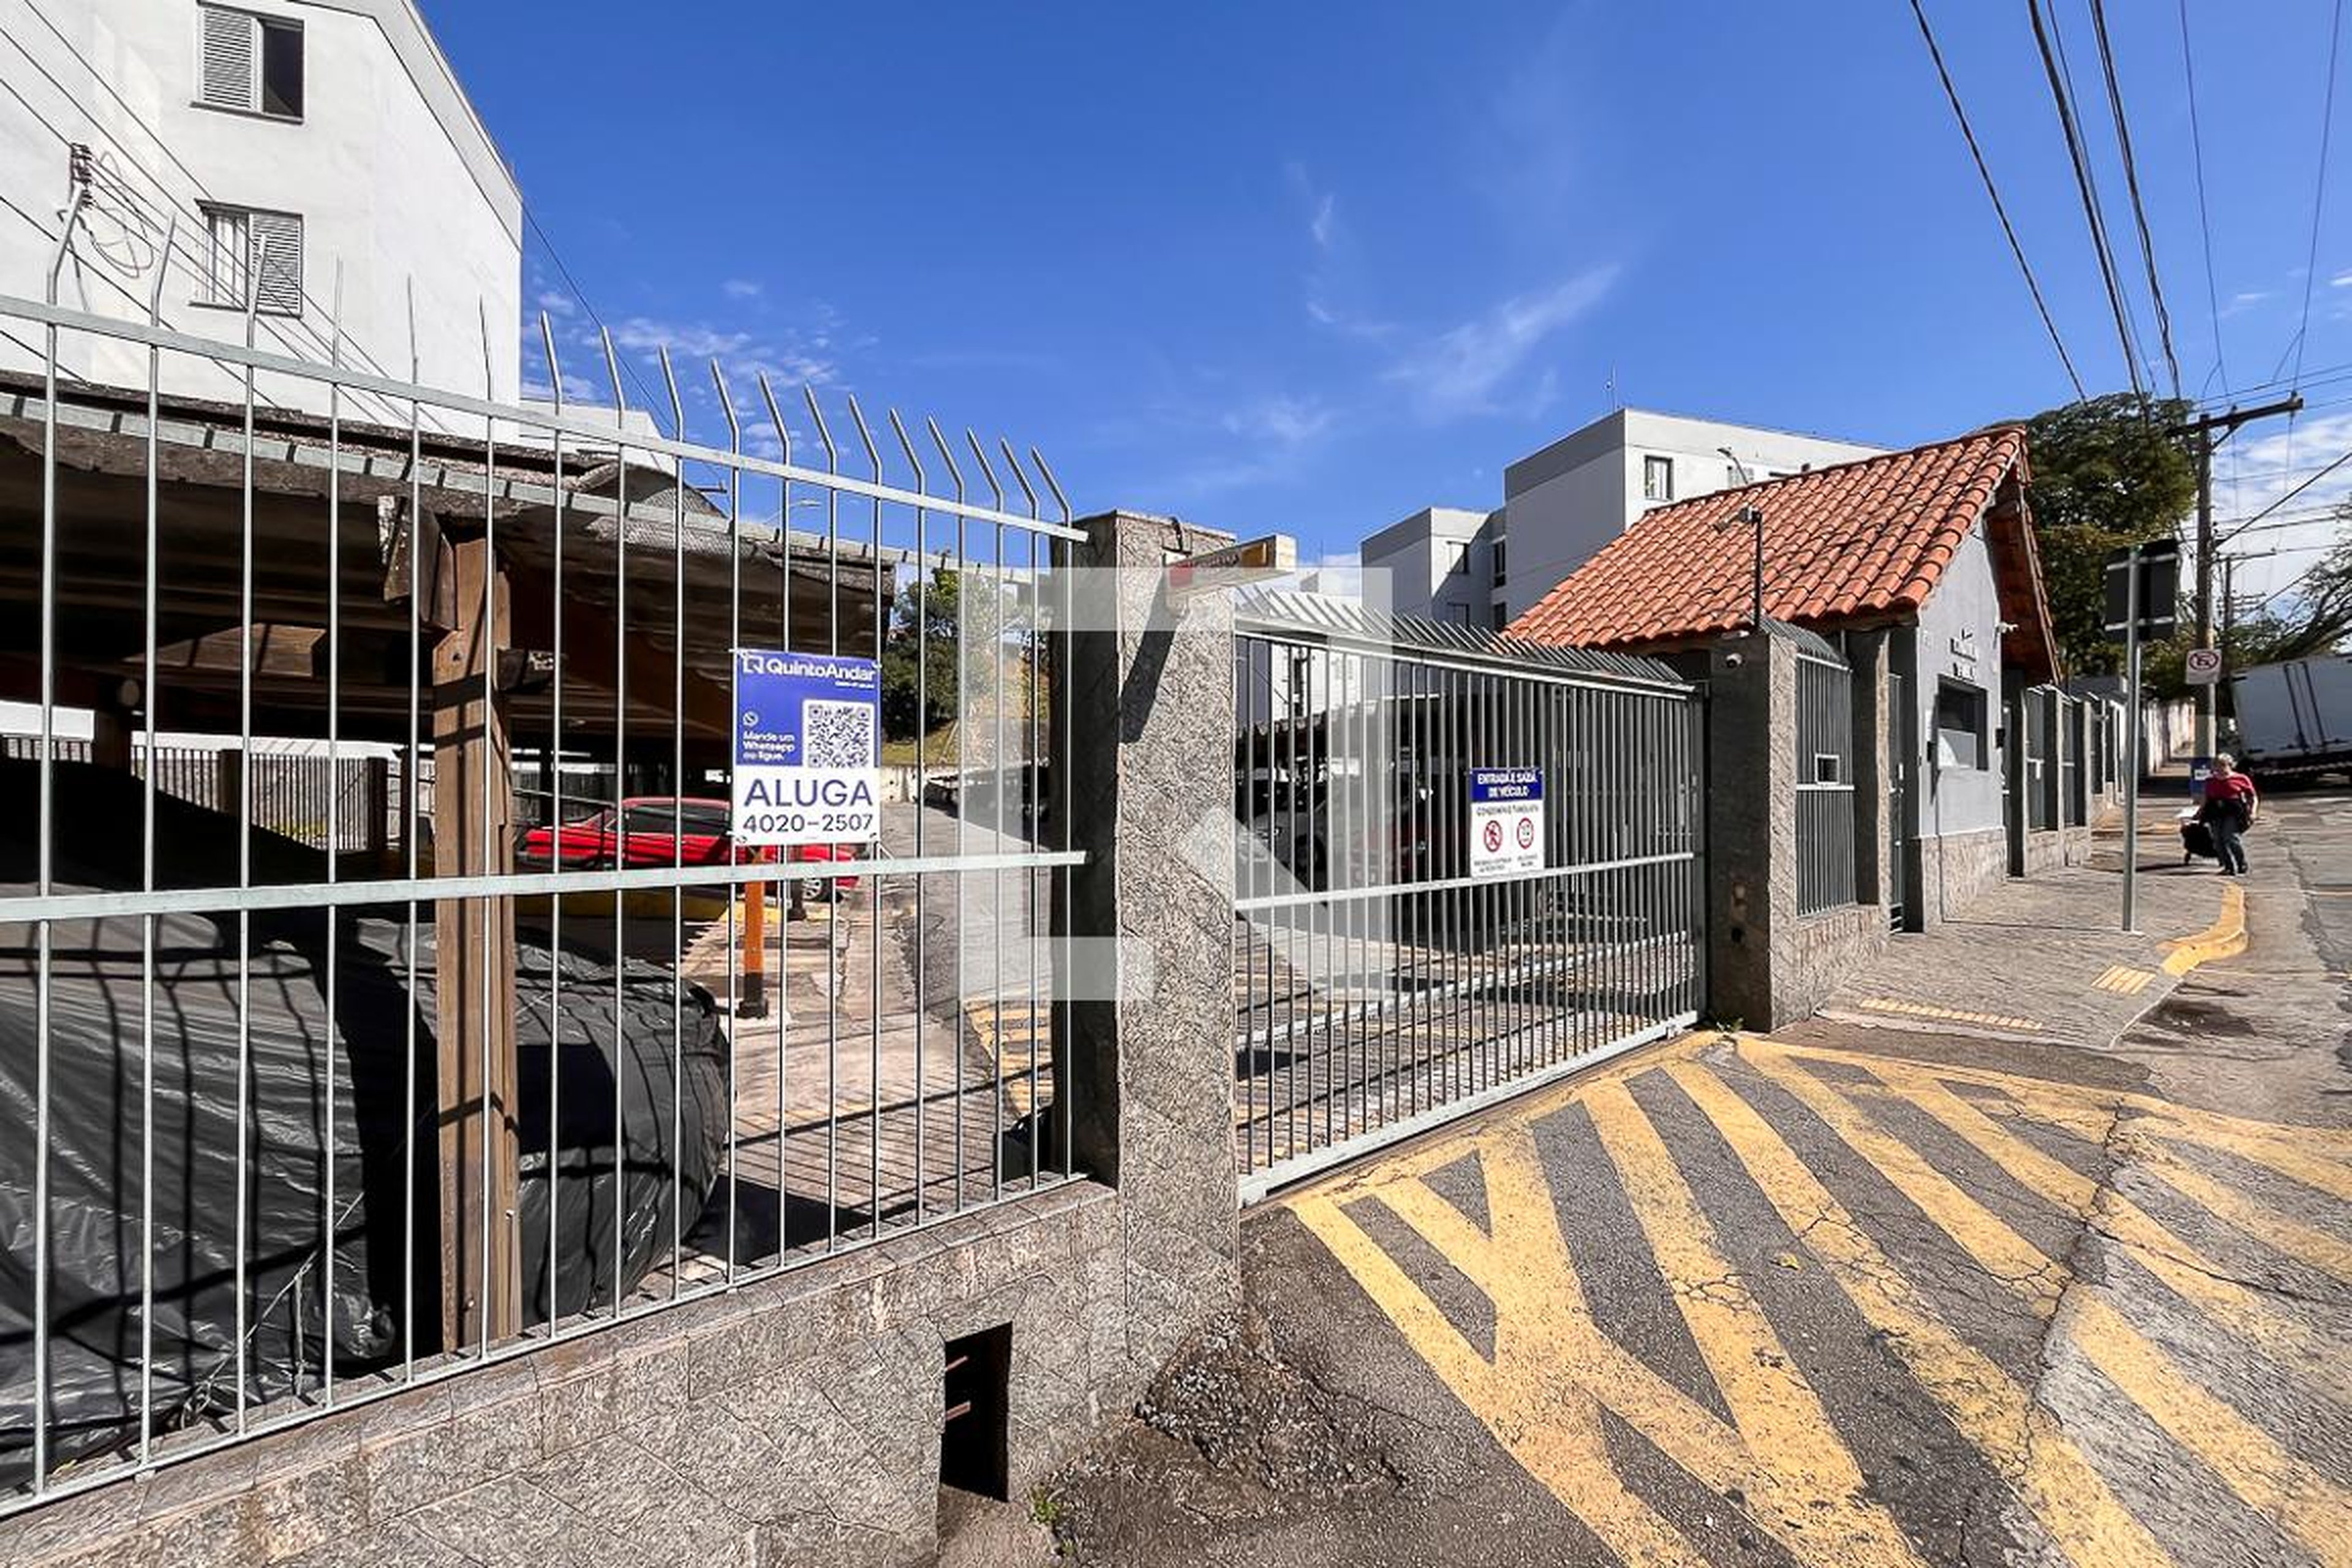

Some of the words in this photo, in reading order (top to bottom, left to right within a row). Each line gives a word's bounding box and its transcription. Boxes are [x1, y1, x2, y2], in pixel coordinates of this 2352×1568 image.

[766, 658, 876, 681] QuintoAndar
[743, 731, 777, 742] Mande
[779, 734, 795, 743] um
[744, 778, 873, 807] ALUGA
[743, 813, 873, 832] 4020-2507
